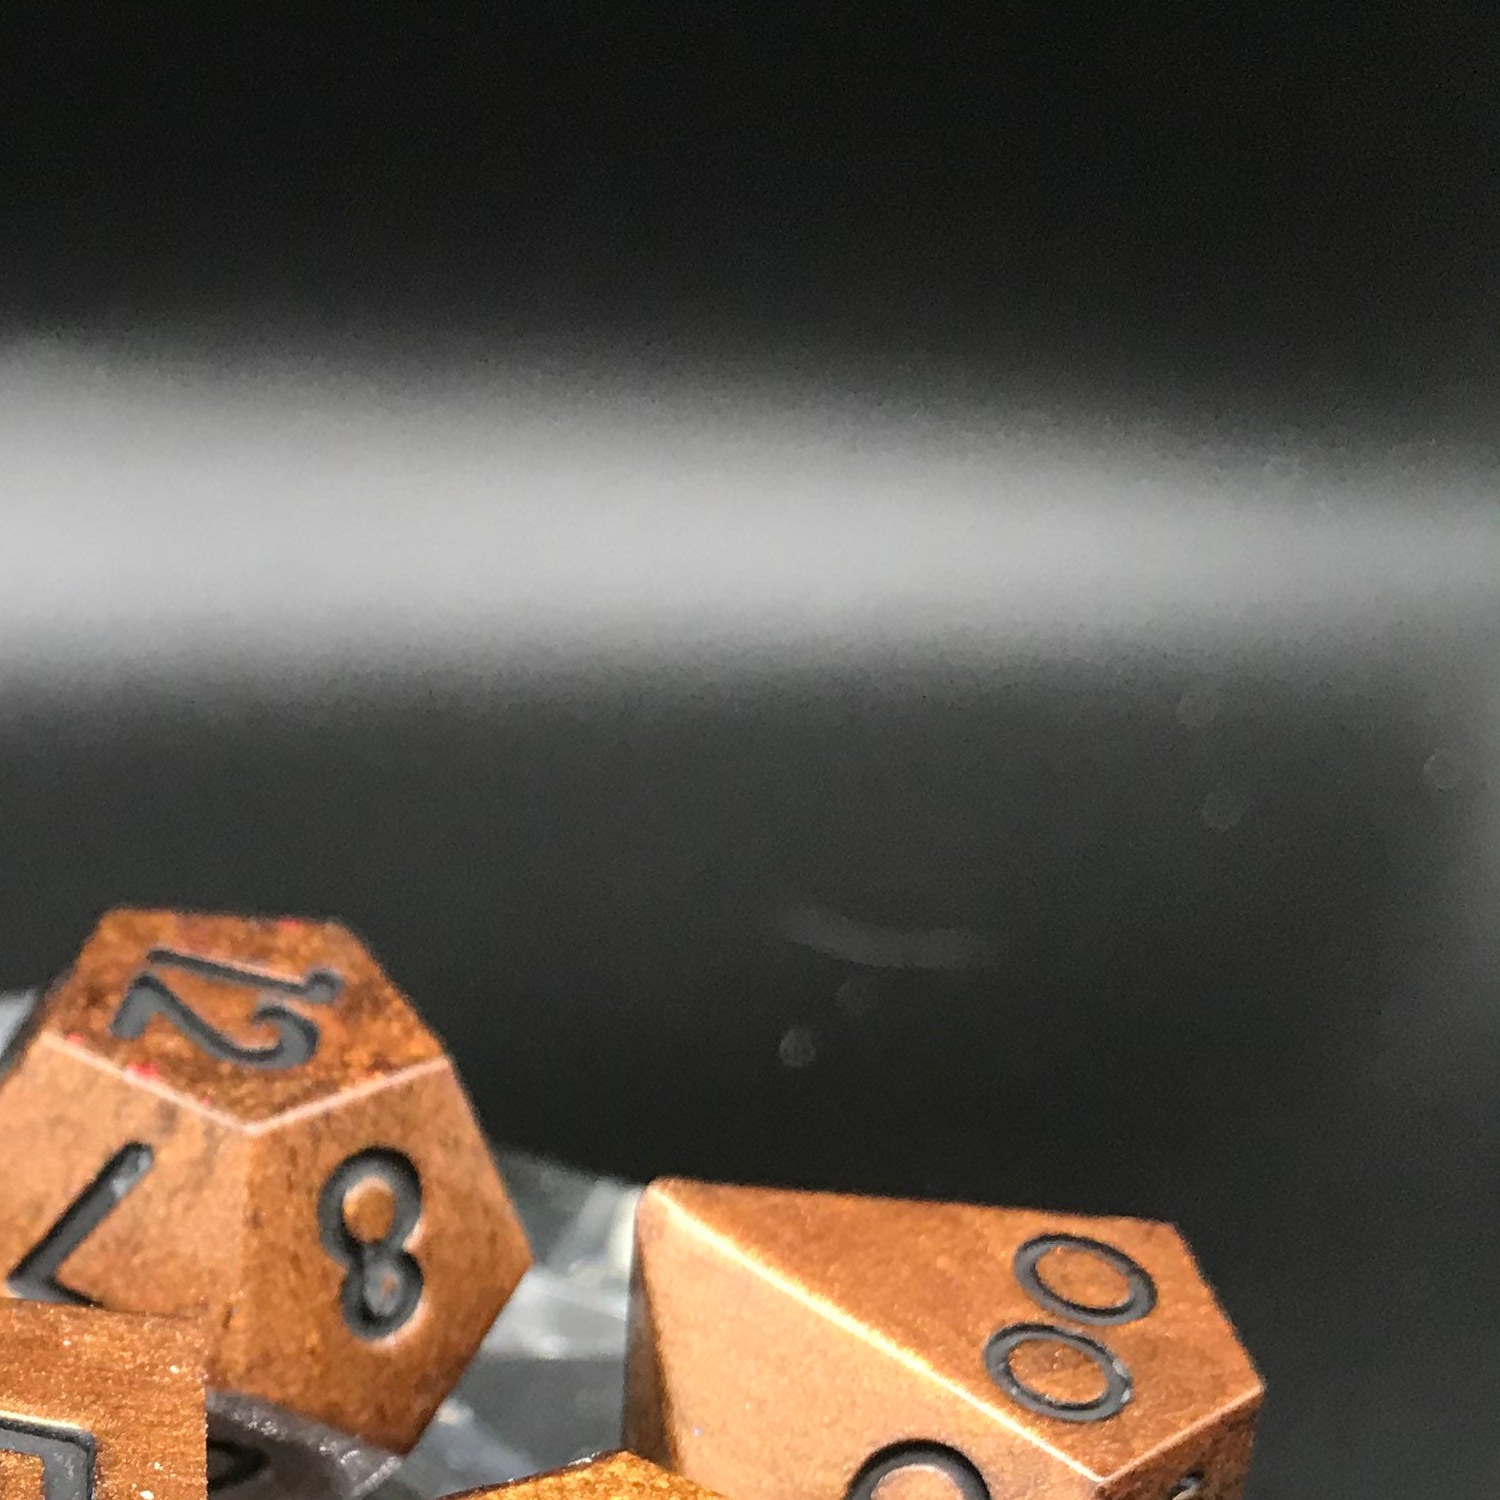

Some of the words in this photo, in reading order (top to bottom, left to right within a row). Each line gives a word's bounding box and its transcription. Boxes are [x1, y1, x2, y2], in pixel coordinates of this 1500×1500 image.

[111, 947, 345, 1072] 12
[317, 1145, 425, 1342] 8
[983, 1232, 1158, 1423] 00
